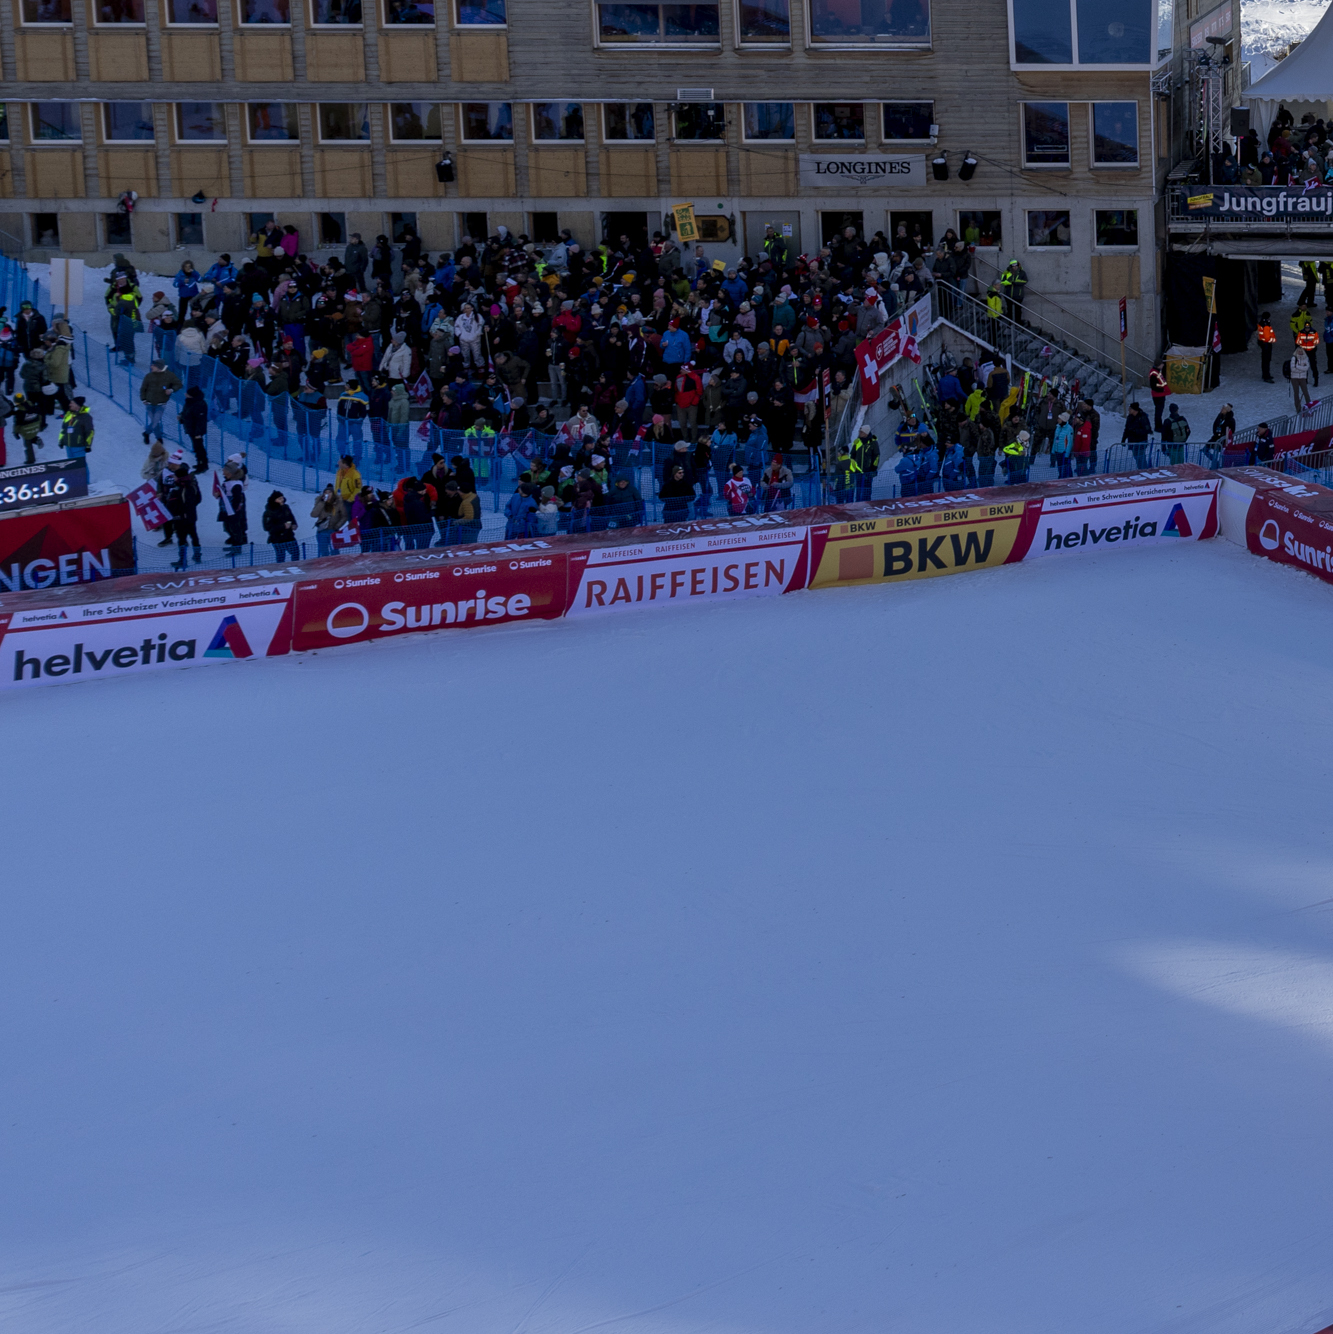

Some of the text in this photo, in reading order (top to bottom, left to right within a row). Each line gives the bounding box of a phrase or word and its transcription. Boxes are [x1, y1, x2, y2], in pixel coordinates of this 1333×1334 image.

[816, 161, 911, 174] LONGINES
[0, 465, 46, 480] NGINES
[1067, 469, 1179, 490] swissski
[1237, 467, 1319, 498] swissski
[1050, 483, 1205, 507] helvetia Ihre Schweizer Versicherung helvetia
[863, 492, 985, 515] swissski
[989, 504, 1014, 516] BKW
[1274, 501, 1290, 514] Sunrise
[896, 515, 922, 527] BKW
[943, 510, 969, 522] BKW
[1298, 511, 1315, 524] Sunrise
[655, 515, 790, 537] swissski
[849, 521, 876, 533] BKW
[758, 530, 797, 543] RAIFFEISEN
[1044, 515, 1157, 551] helvetia
[655, 542, 696, 554] RAIFFEISEN
[707, 536, 747, 548] RAIFFEISEN
[405, 540, 553, 562] swissski
[602, 548, 643, 560] RAIFFEISEN
[883, 528, 995, 577] BKW
[463, 564, 497, 576] Sunrise
[520, 558, 552, 569] Sunrise
[140, 567, 306, 592] swissski
[346, 576, 381, 588] Sunrise
[405, 570, 440, 582] Sunrise
[585, 558, 785, 609] RAIFFEISEN
[22, 589, 271, 623] helvetia Ihre Schweizer Versicherung helvetia
[379, 589, 531, 632] Sunrise
[13, 633, 197, 681] helvetia
